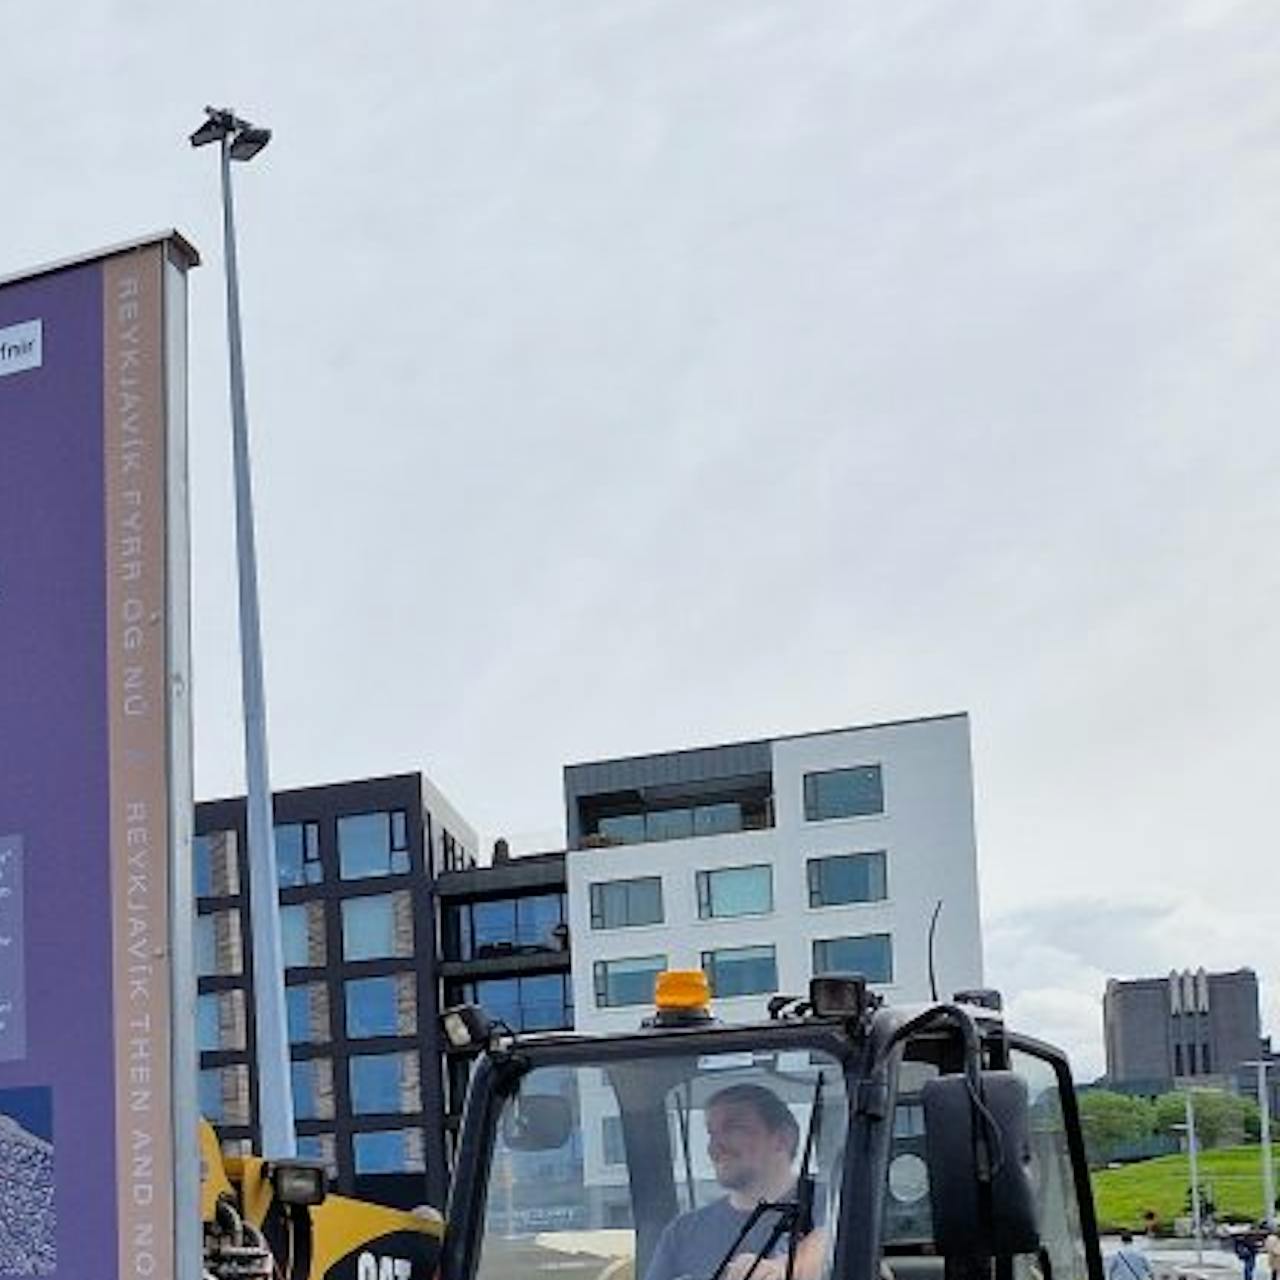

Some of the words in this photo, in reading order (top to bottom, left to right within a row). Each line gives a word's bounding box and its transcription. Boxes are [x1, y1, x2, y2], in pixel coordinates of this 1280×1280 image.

[123, 598, 144, 651] OG
[128, 1013, 152, 1113] THEN
[131, 1129, 154, 1206] AND
